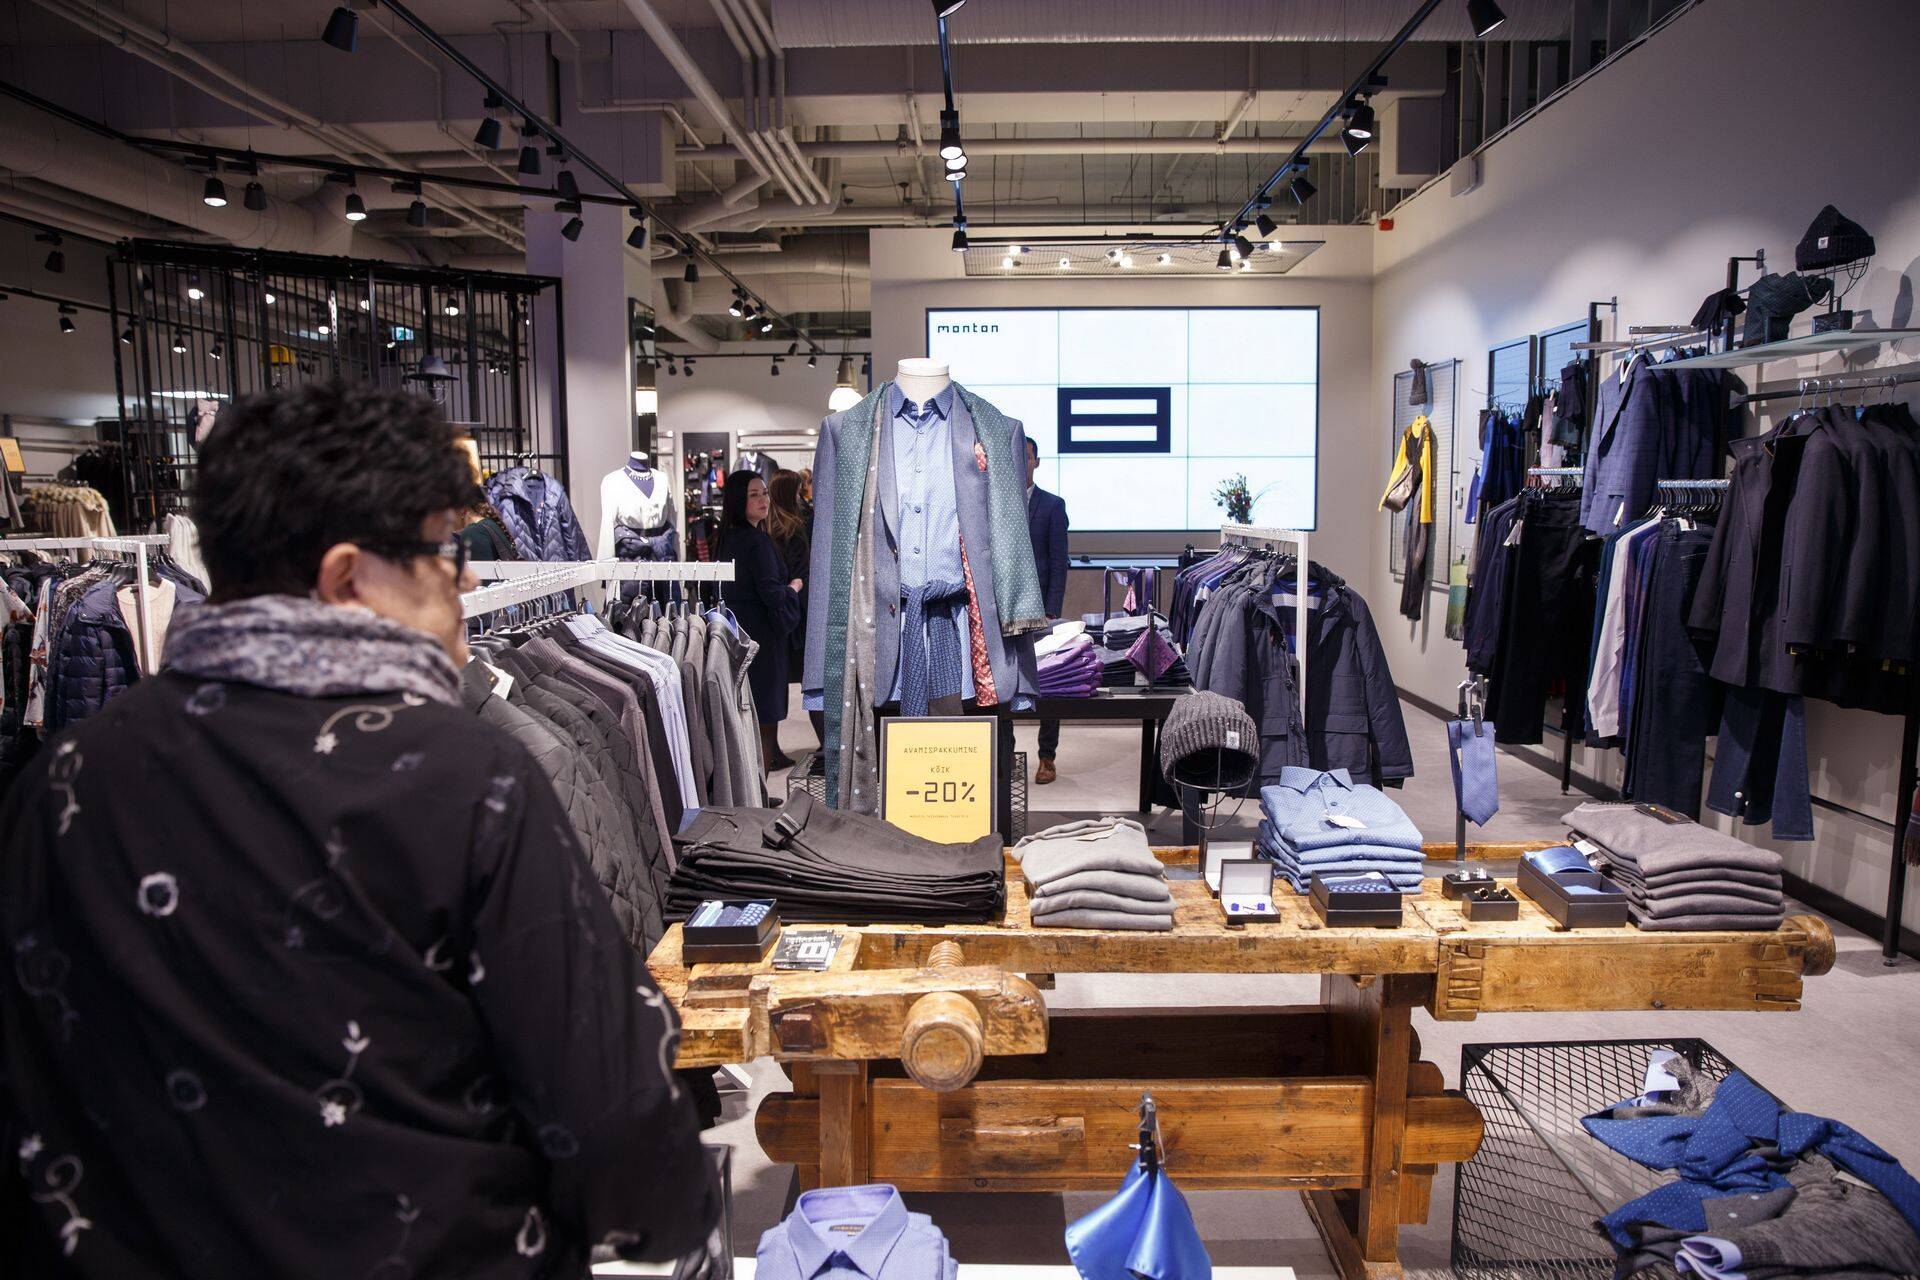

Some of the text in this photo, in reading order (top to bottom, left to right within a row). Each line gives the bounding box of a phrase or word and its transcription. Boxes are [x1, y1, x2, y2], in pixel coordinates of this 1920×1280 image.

[937, 323, 999, 333] monton
[930, 765, 951, 773] KÕIK
[906, 782, 975, 802] -20%
